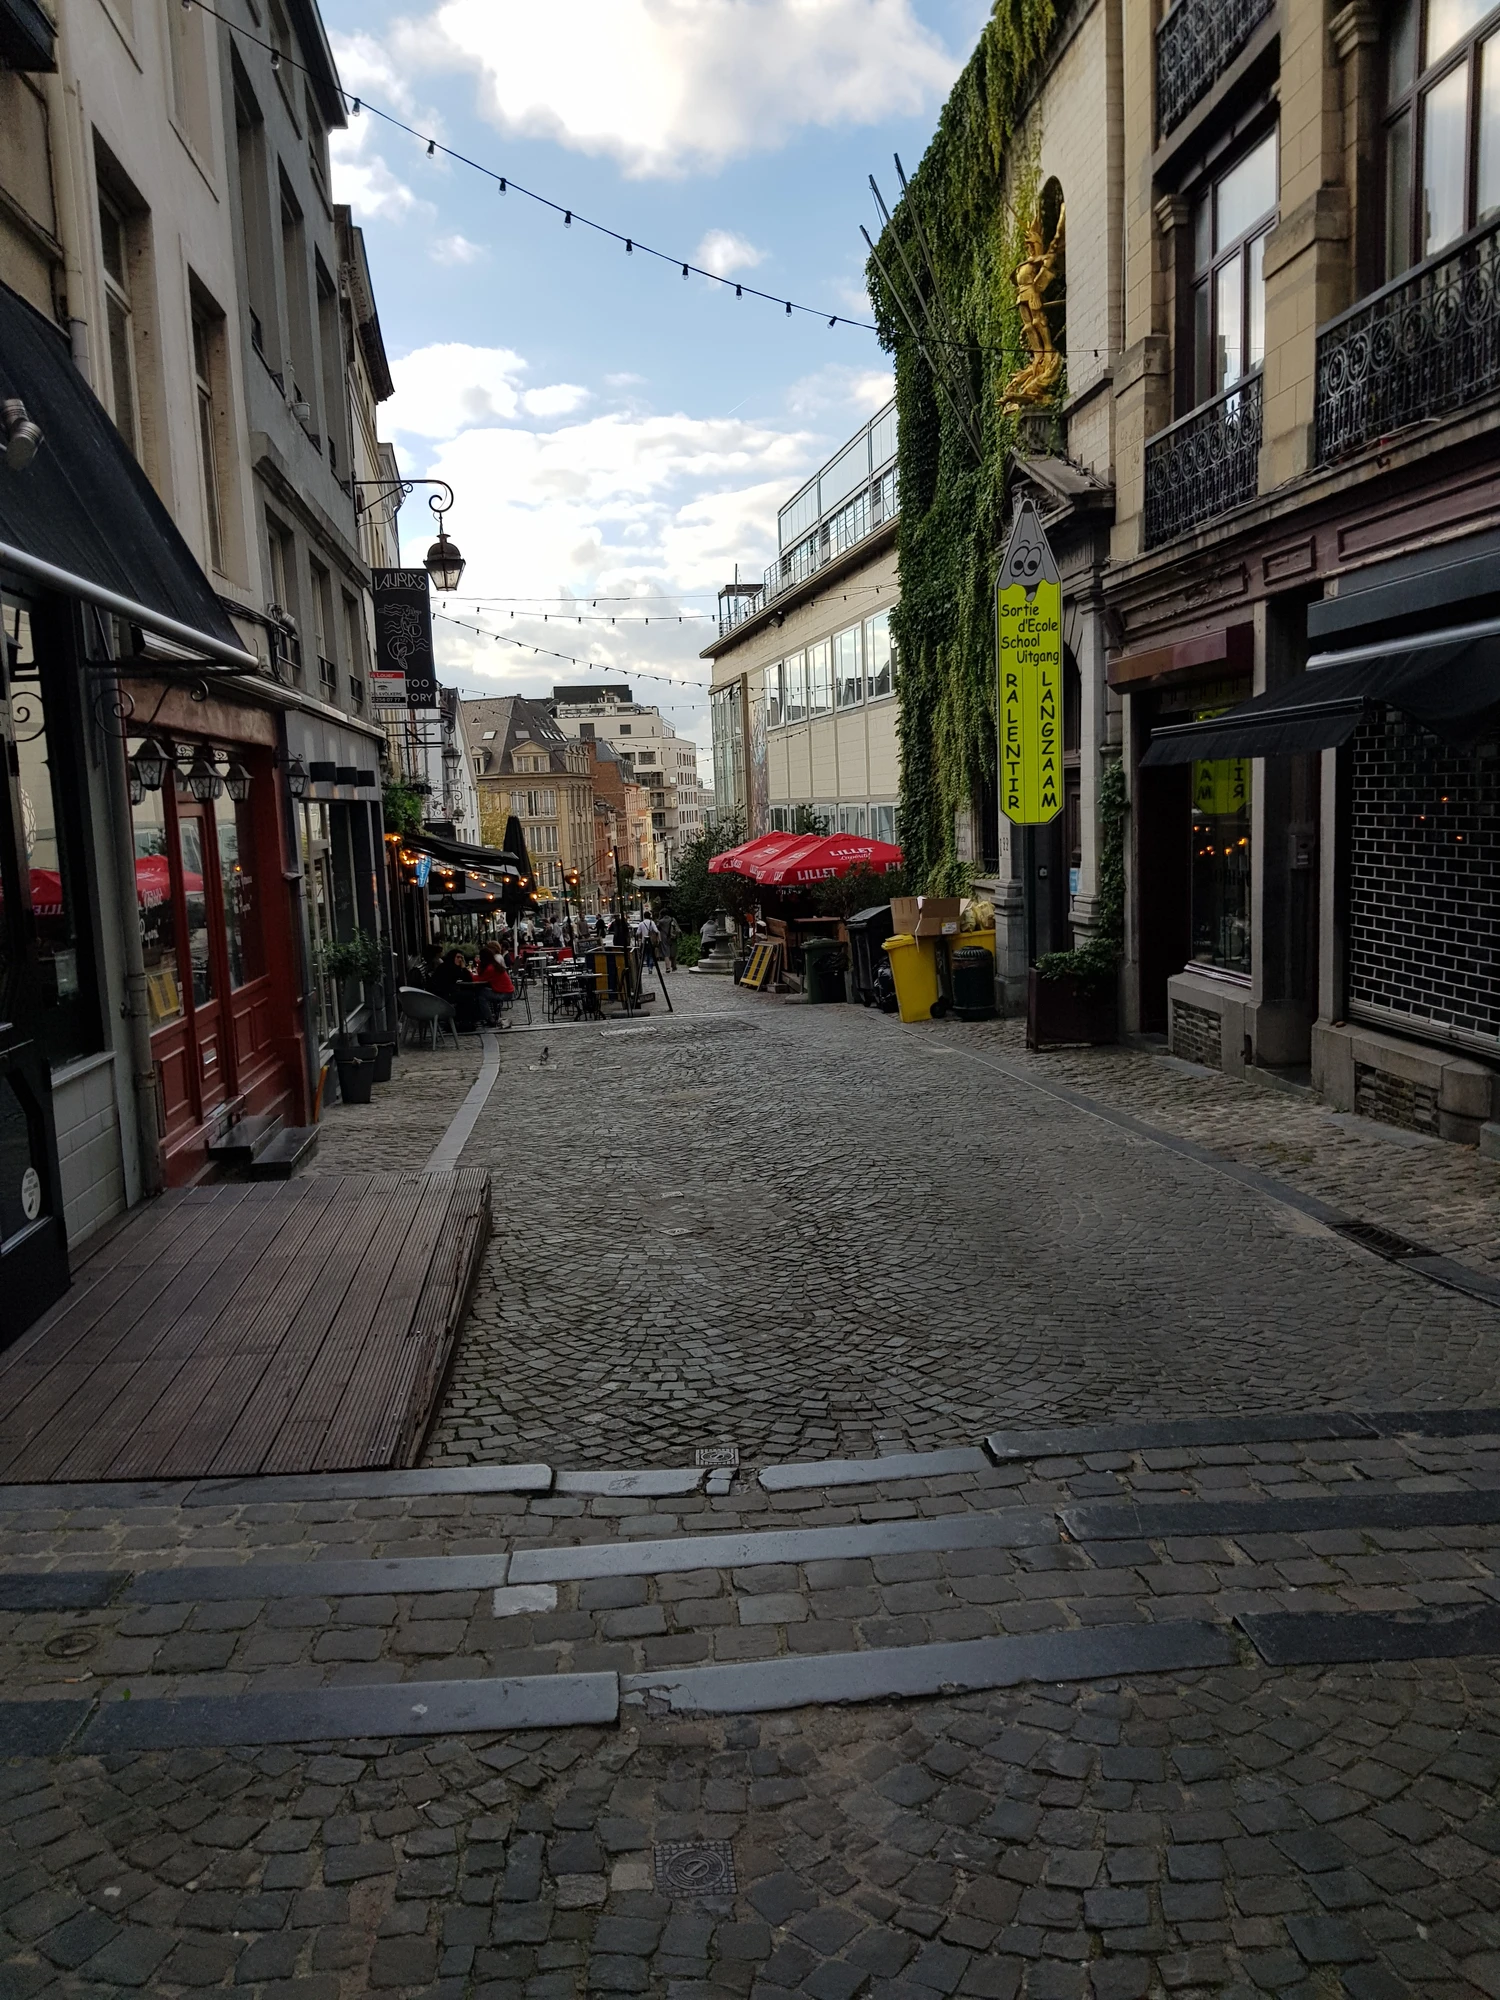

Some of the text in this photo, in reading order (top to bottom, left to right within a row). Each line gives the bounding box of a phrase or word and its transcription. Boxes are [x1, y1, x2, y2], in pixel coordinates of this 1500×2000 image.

[1000, 603, 1040, 618] Sortie
[1017, 618, 1059, 633] d'Ecole
[1001, 634, 1040, 649] School
[1016, 650, 1060, 667] Uitgang
[1006, 673, 1020, 809] RALENTIR
[1041, 671, 1057, 808] LANGZAAM
[829, 847, 875, 857] LILLET
[796, 867, 838, 881] LILLET
